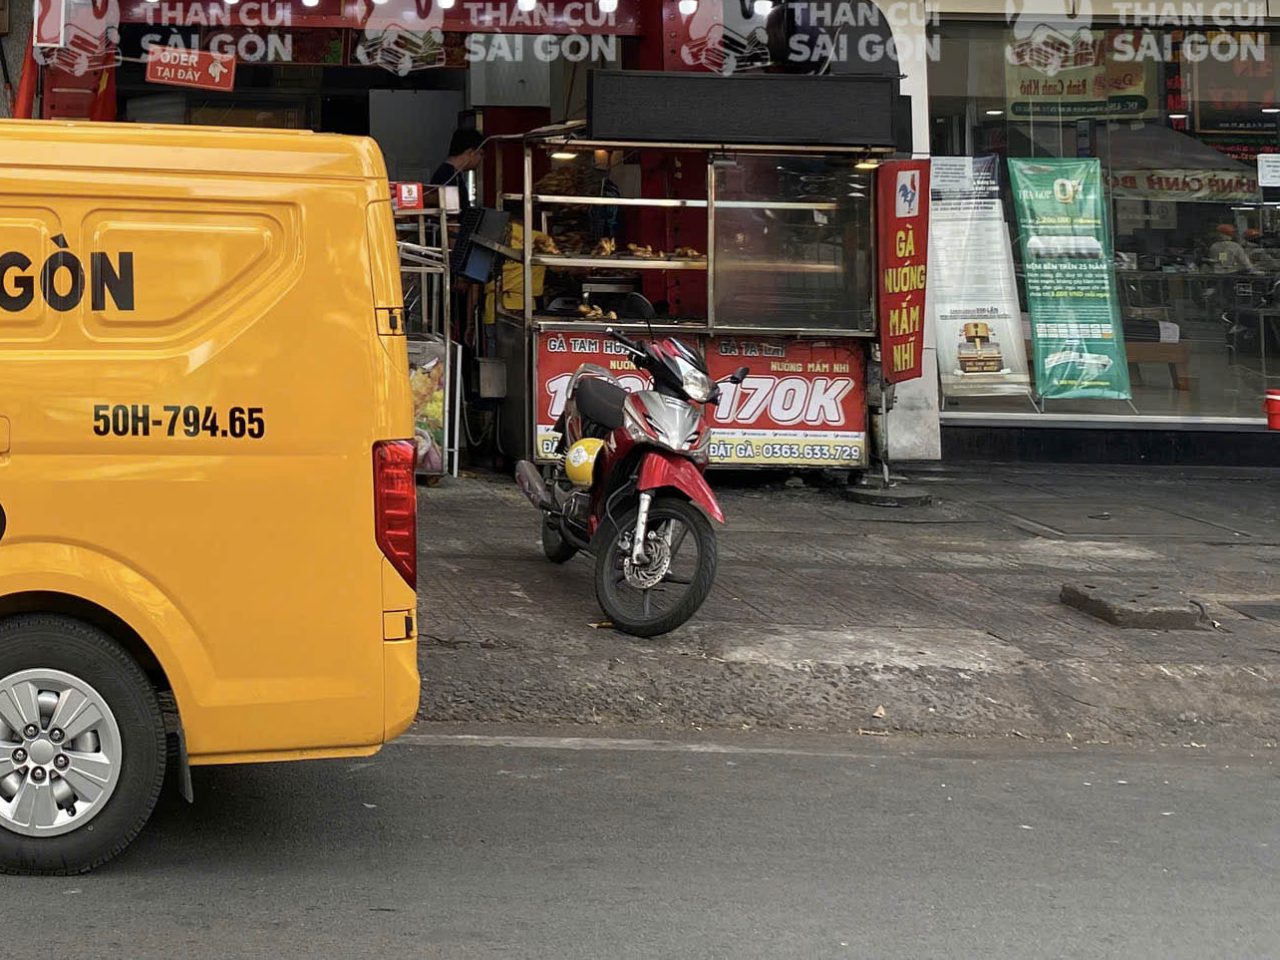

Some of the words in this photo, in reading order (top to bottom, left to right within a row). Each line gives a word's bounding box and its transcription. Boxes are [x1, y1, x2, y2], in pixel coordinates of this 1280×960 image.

[156, 66, 174, 80] TẠI
[177, 69, 201, 82] ĐÂY
[160, 52, 199, 67] ODER
[896, 224, 915, 258] GÀ
[884, 260, 926, 293] NƯỚNG
[889, 294, 920, 337] MẮM
[548, 333, 567, 352] GÀ
[570, 338, 599, 353] TAM
[893, 337, 916, 372] NHĨ
[714, 375, 854, 425] 170K
[92, 404, 264, 440] 50H-794.65
[709, 440, 734, 459] ĐẶT
[736, 440, 754, 457] GÀ
[762, 444, 860, 460] 0363.633.729
